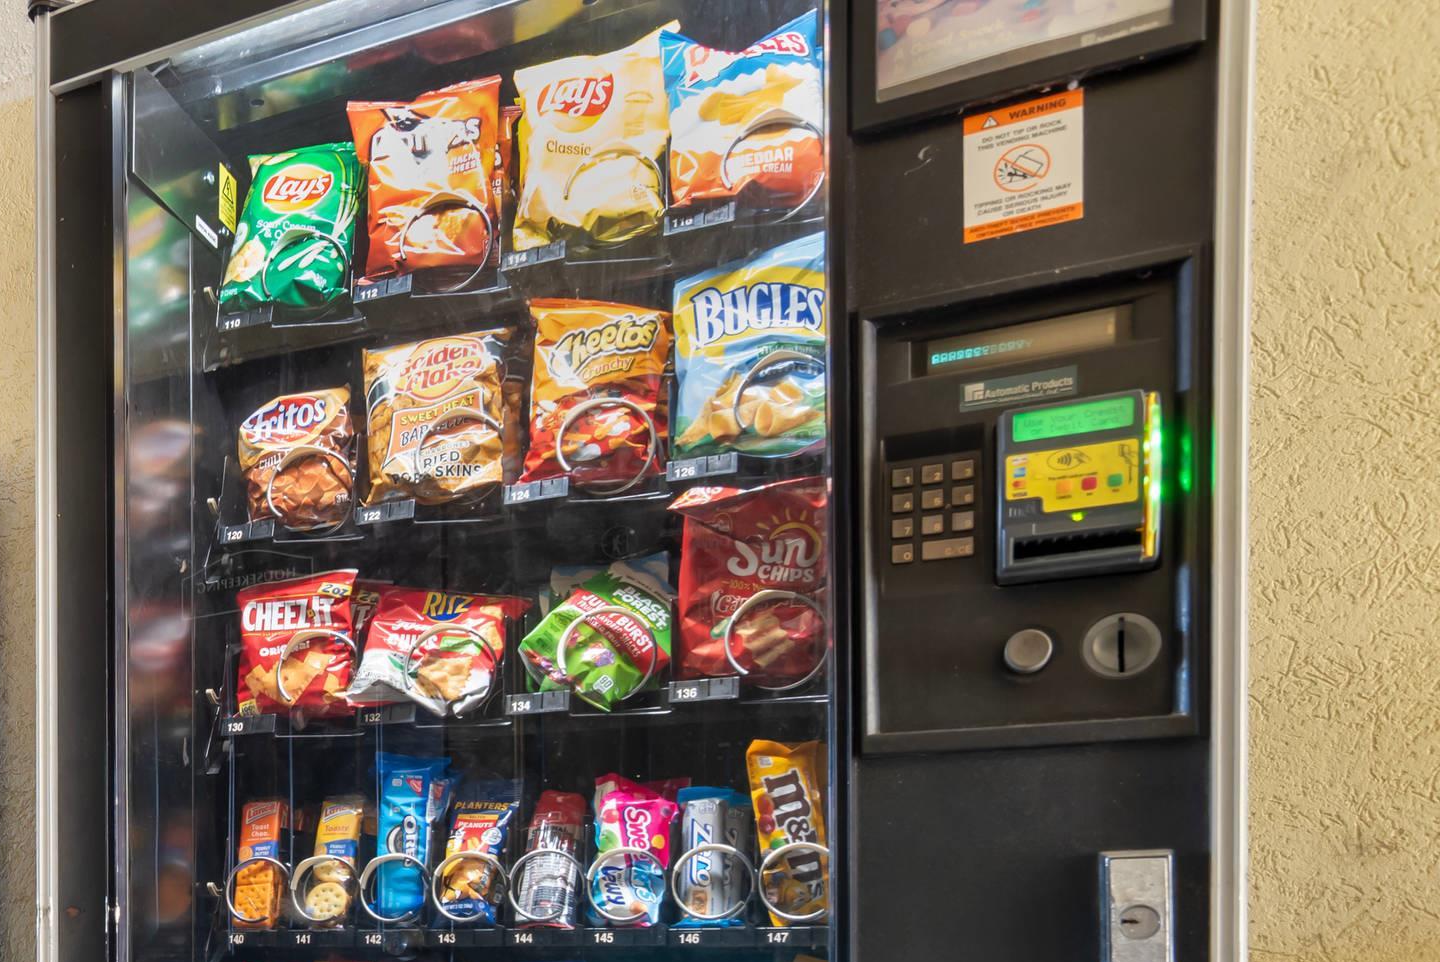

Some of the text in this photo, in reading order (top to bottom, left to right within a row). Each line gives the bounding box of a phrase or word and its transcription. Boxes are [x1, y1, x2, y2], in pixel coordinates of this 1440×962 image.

[541, 78, 611, 117] Lay's
[1009, 99, 1067, 119] WARNING
[995, 132, 1010, 140] NOT
[1013, 128, 1024, 136] TIP
[997, 136, 1029, 147] VENDING
[1031, 125, 1067, 138] MACHINE
[546, 140, 591, 156] Classic
[265, 175, 330, 204] Lay's
[1055, 183, 1071, 192] MAY
[509, 255, 527, 266] 114
[360, 290, 378, 300] 112
[690, 282, 825, 350] BUGLES
[224, 319, 241, 329] 110
[581, 357, 634, 383] Crunchy
[984, 384, 1030, 400] Automatic
[1031, 377, 1073, 392] Products
[401, 395, 474, 425] SWEET HEAT
[243, 399, 327, 443] Fritos
[423, 450, 461, 468] RIED
[675, 467, 695, 478] 126
[511, 490, 530, 501] 124
[363, 512, 381, 521] 122
[227, 530, 243, 540] 120
[727, 537, 822, 577] Sun
[757, 565, 814, 582] CHIPS
[322, 584, 332, 593] 2
[422, 591, 476, 617] RITZ
[612, 588, 667, 630] FOREST
[624, 586, 670, 621] BLACK
[616, 616, 654, 653] BURST
[676, 688, 697, 698] 136
[511, 701, 530, 711] 134
[364, 713, 381, 723] 132
[227, 722, 243, 732] 130
[455, 801, 509, 811] PLANTERS
[251, 823, 270, 831] Toast
[458, 821, 494, 829] PEANUTS
[229, 935, 244, 945] 140
[296, 935, 310, 945] 141
[365, 934, 381, 944] 142
[438, 934, 456, 944] 143
[514, 932, 533, 943] 144
[594, 932, 614, 943] 145
[679, 933, 700, 944] 146
[767, 932, 789, 943] 147
